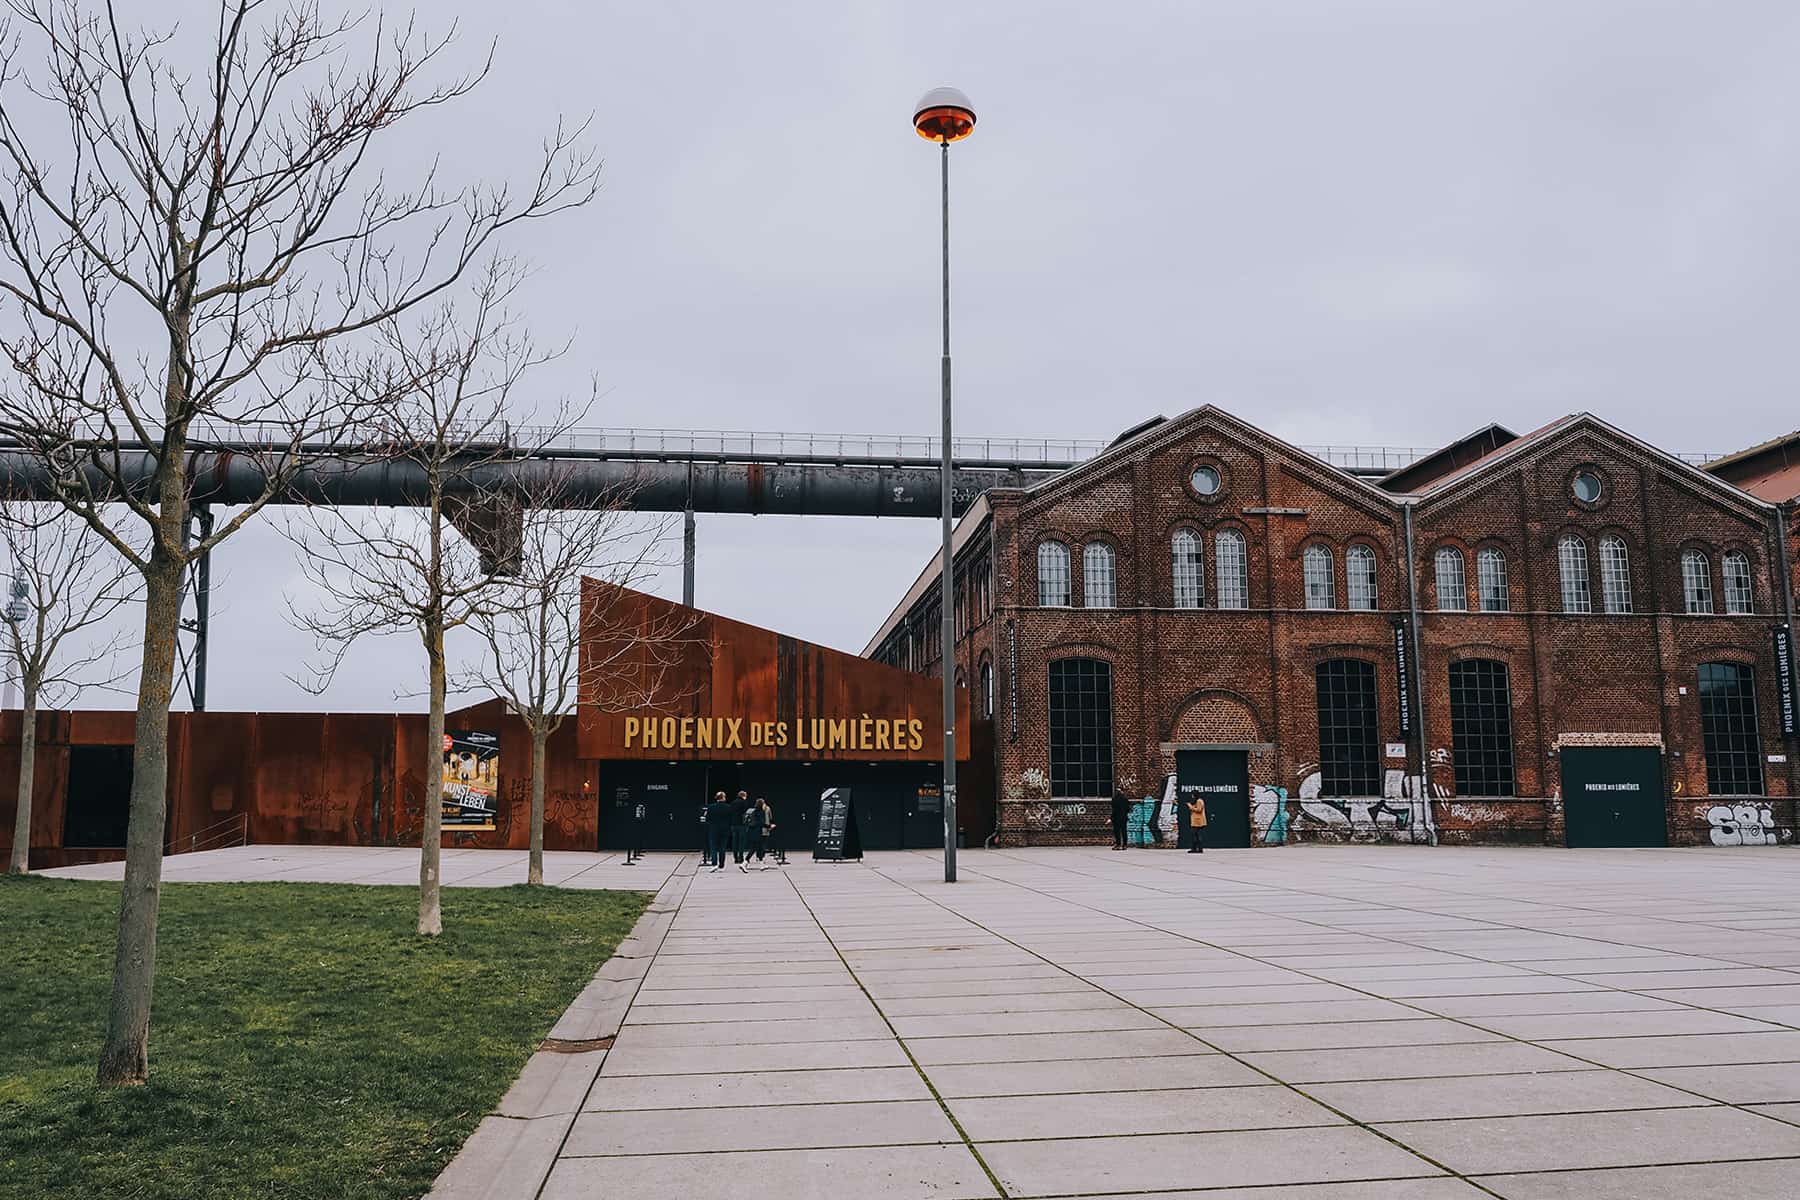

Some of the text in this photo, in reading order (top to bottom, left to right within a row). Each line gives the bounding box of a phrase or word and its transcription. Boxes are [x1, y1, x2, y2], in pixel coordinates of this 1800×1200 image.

[1782, 693, 1793, 733] PHOENIX
[624, 713, 923, 750] PHOENIX DES LUMIÈRES
[443, 782, 472, 796] KUNST
[460, 794, 487, 809] LEBEN
